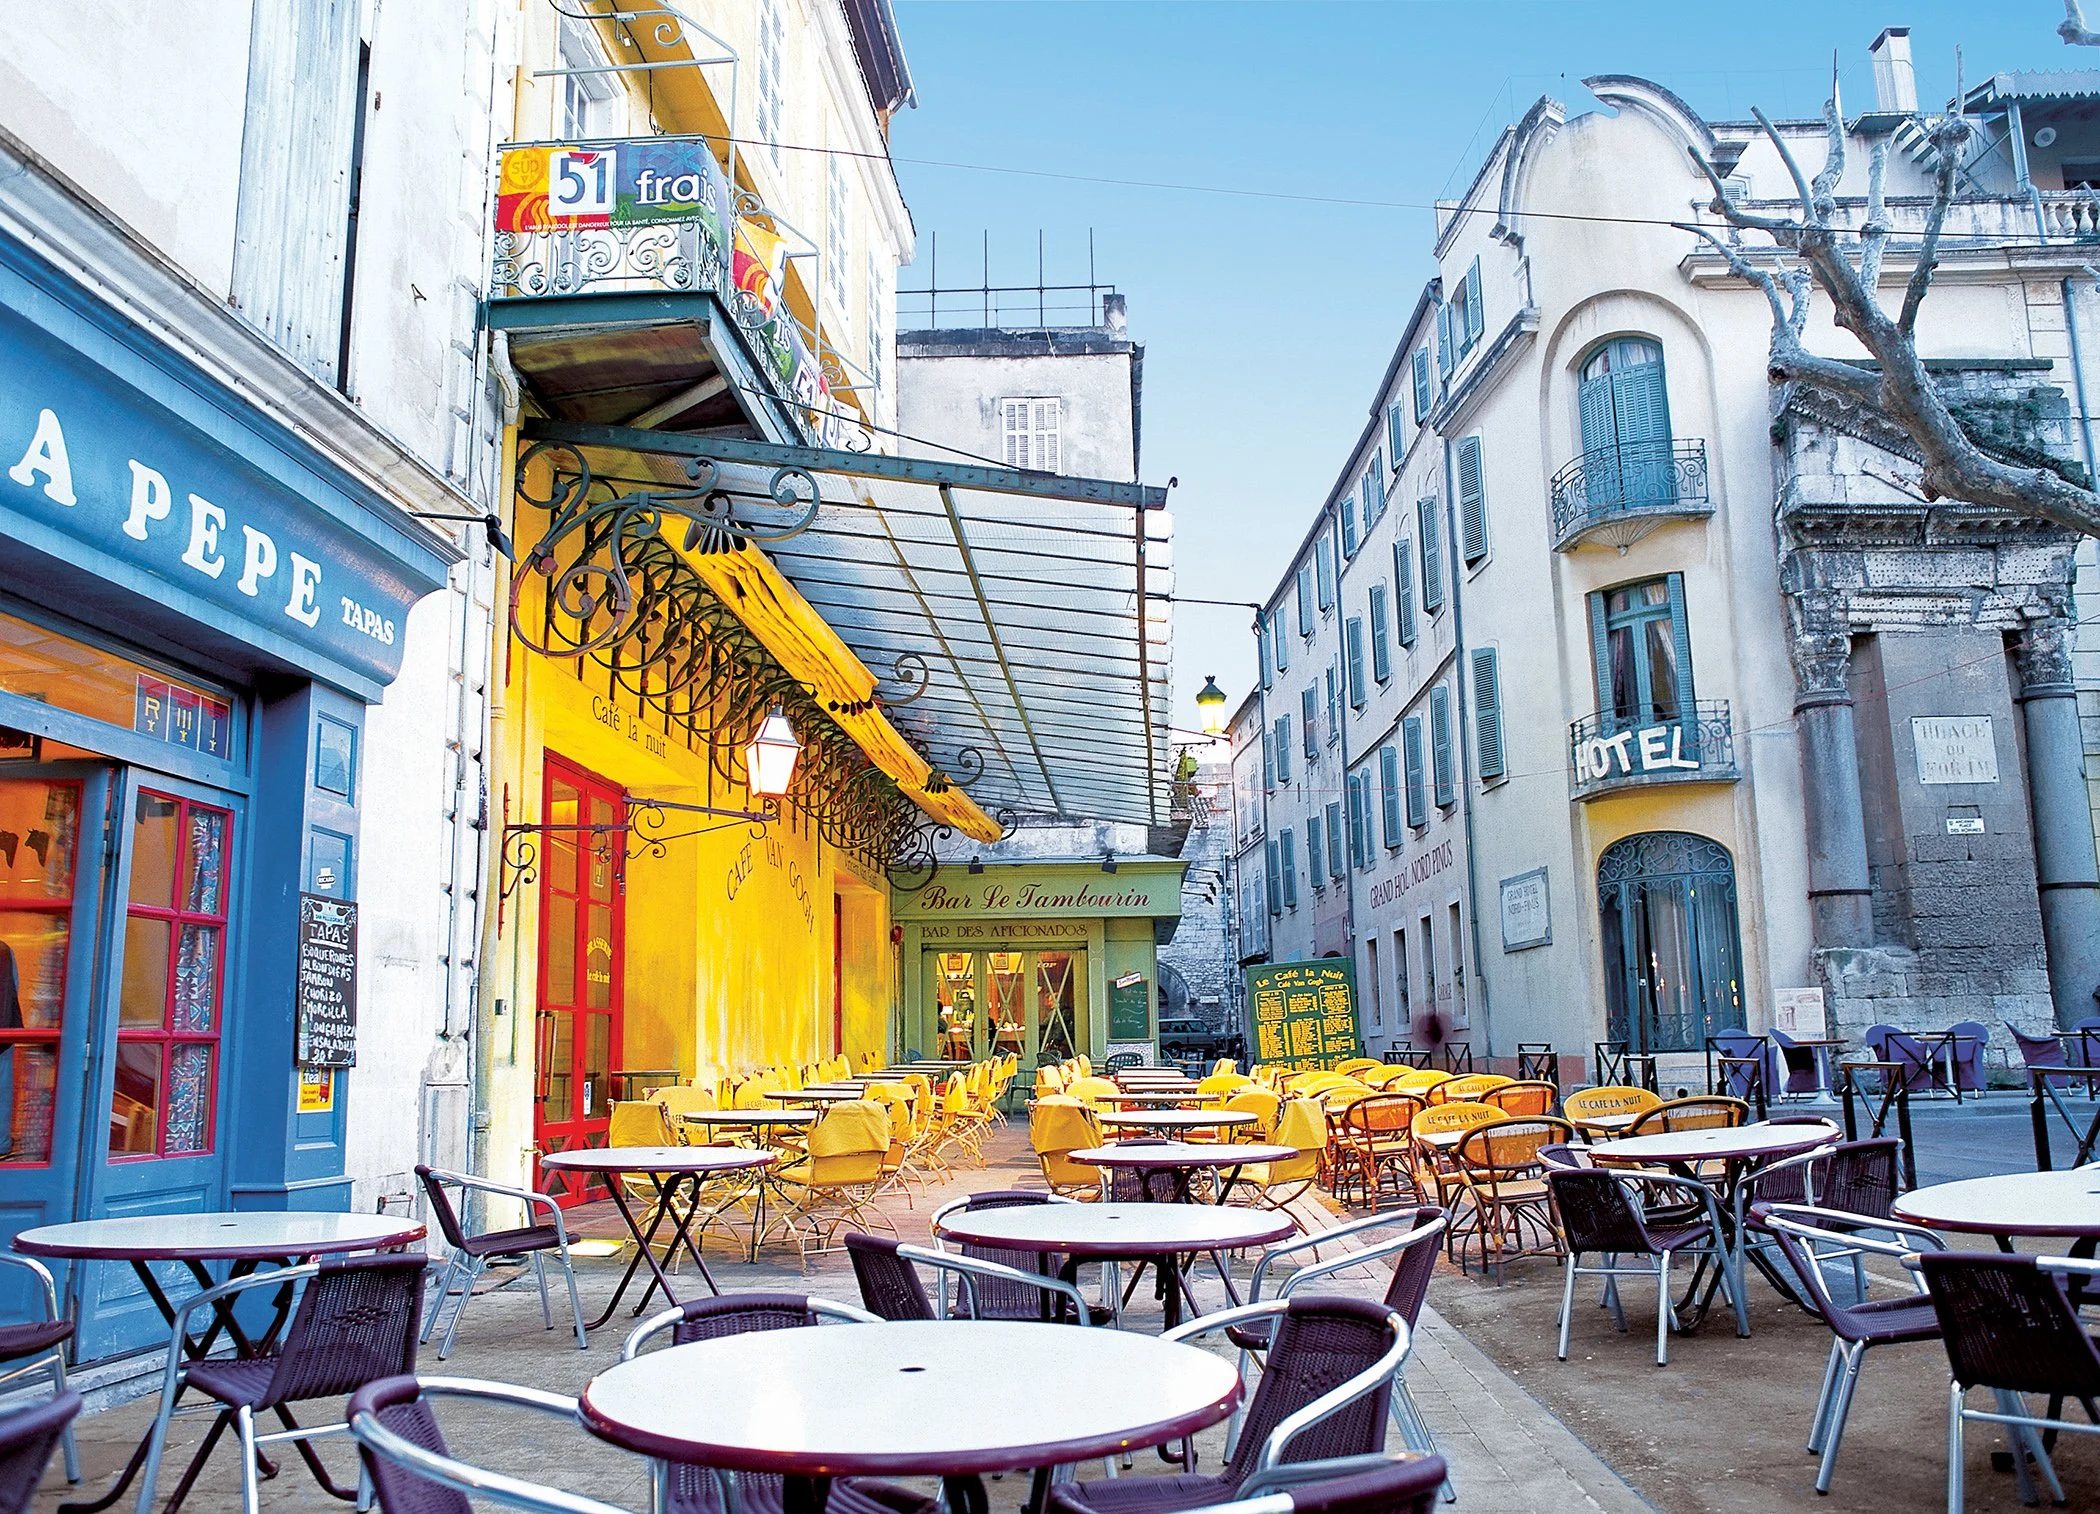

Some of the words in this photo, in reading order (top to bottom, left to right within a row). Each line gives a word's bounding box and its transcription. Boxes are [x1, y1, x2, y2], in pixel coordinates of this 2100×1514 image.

[558, 156, 608, 205] 51
[635, 168, 717, 214] frais
[578, 221, 610, 229] DANGEREUX
[610, 220, 624, 228] POUR
[651, 216, 685, 225] CONSOMMEZ
[9, 408, 77, 507] A
[122, 458, 323, 629] PEPE
[340, 596, 396, 646] TAPAS
[592, 695, 620, 732] Café
[627, 714, 638, 742] la
[645, 734, 666, 759] nuit
[1575, 726, 1700, 783] HOTEL
[765, 836, 784, 870] VAN
[789, 861, 815, 934] GOGH
[1370, 879, 1393, 909] GRAND
[1411, 853, 1431, 887] NORD
[1432, 838, 1453, 876] PINUS
[921, 885, 973, 911] Bar
[980, 884, 1011, 911] Le
[1016, 883, 1151, 909] Tambourin
[308, 923, 350, 944] TAPAS
[921, 926, 950, 938] BAR
[957, 926, 984, 938] DES
[990, 924, 1088, 938] AFICIONADOS
[1256, 978, 1270, 988] Le
[1274, 970, 1299, 981] Café
[1305, 968, 1315, 977] la
[1321, 969, 1344, 980] Nuit
[303, 984, 343, 1003] CHORIZO
[304, 1072, 319, 1084] Tea
[1579, 1099, 1587, 1109] LE
[1588, 1098, 1608, 1110] CAFE
[1611, 1098, 1621, 1108] LA
[1623, 1094, 1642, 1106] NUIT
[1427, 1116, 1435, 1125] LE
[1459, 1113, 1469, 1123] LA
[1471, 1110, 1490, 1121] NUIT
